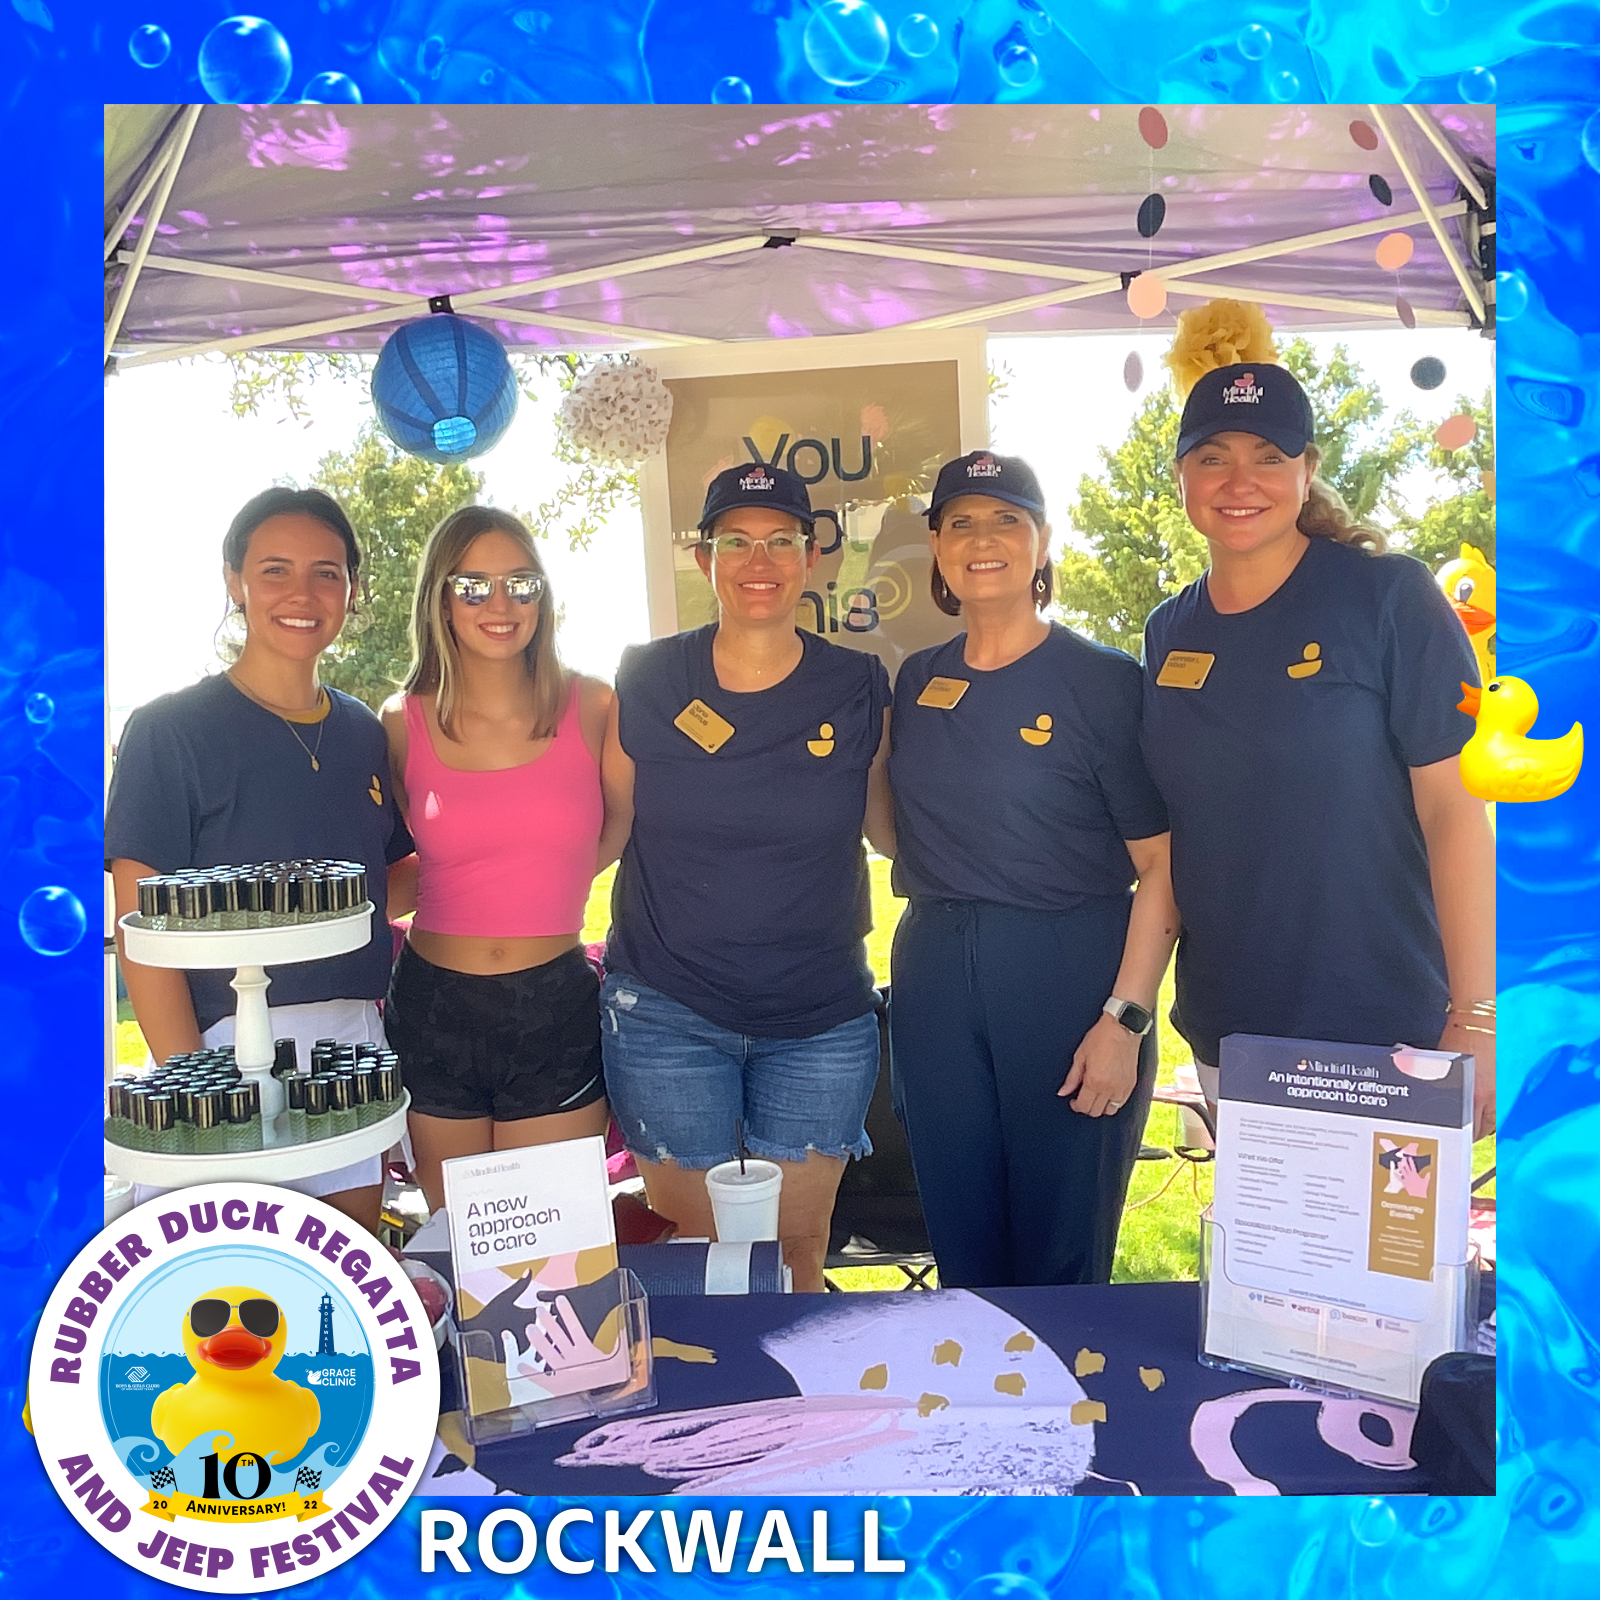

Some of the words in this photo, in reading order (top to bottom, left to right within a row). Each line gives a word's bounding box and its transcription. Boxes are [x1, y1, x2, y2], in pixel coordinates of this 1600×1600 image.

[1223, 385, 1264, 397] Mindful
[1224, 395, 1259, 405] Health
[742, 434, 871, 484] You
[966, 463, 1002, 473] Mindful
[739, 477, 775, 486] Mindful
[1308, 1060, 1346, 1075] Mindful
[1346, 1064, 1380, 1079] Health
[1268, 1071, 1285, 1083] An
[1357, 1082, 1410, 1097] different
[1287, 1086, 1344, 1102] approach
[1345, 1091, 1358, 1104] to
[1359, 1095, 1388, 1107] care
[466, 1202, 482, 1220] A
[484, 1195, 528, 1216] new
[469, 1208, 561, 1238] approach
[471, 1239, 490, 1257] to
[493, 1231, 537, 1252] care
